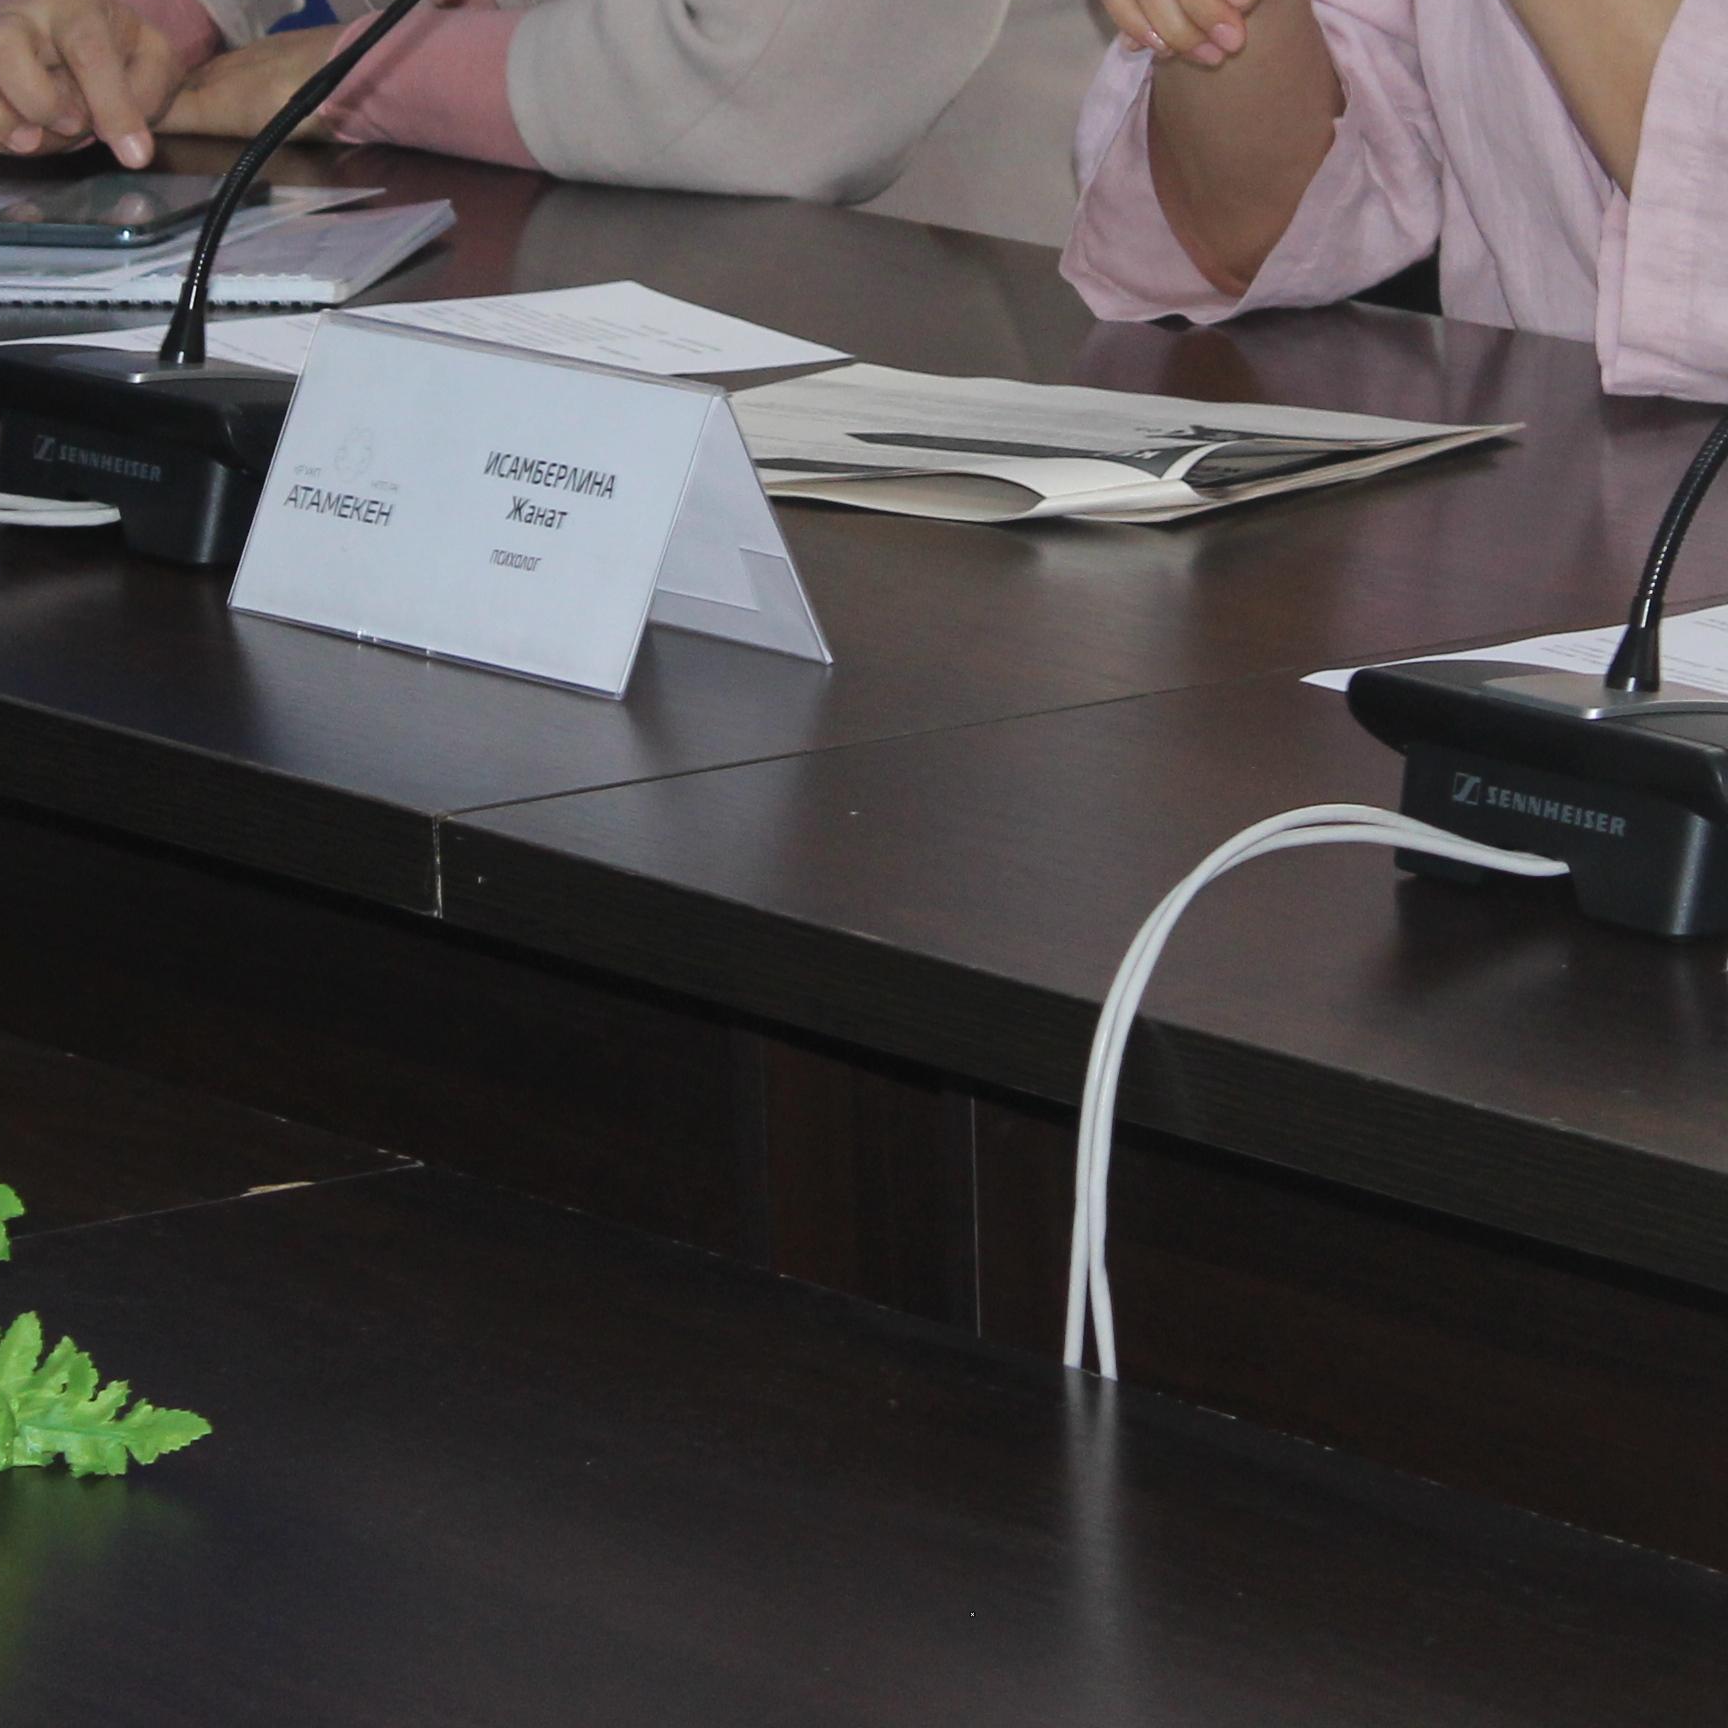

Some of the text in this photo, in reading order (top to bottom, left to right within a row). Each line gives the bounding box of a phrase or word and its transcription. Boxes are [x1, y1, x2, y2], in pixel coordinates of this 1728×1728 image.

[483, 451, 616, 499] ИСАМБЕРЛИНА
[283, 484, 393, 526] АТАМЕКЕН
[505, 496, 568, 529] Жанат
[1486, 786, 1626, 836] SENNHEISER
